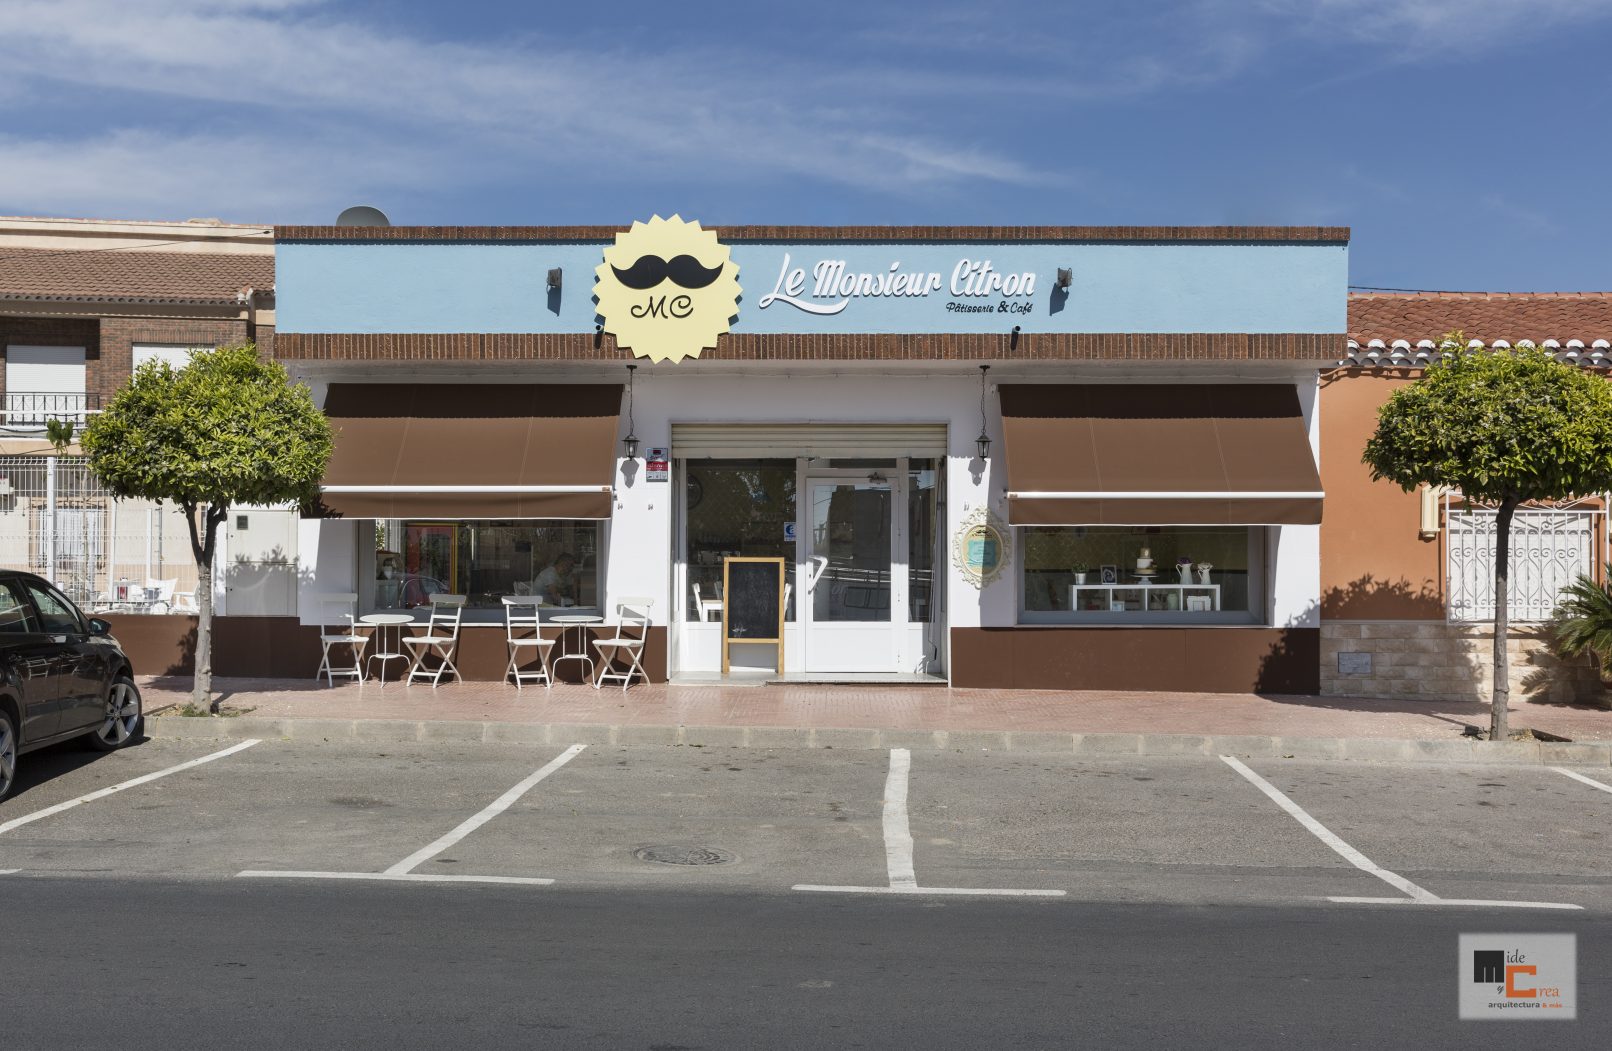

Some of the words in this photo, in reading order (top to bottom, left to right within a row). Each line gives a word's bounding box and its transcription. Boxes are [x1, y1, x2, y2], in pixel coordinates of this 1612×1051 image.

[759, 252, 850, 315] Le
[813, 260, 942, 297] Monsieur
[950, 258, 1036, 296] Citron
[631, 294, 694, 319] MC
[946, 302, 995, 313] Pâtisserie
[997, 300, 1009, 313] &
[1010, 301, 1034, 316] Café
